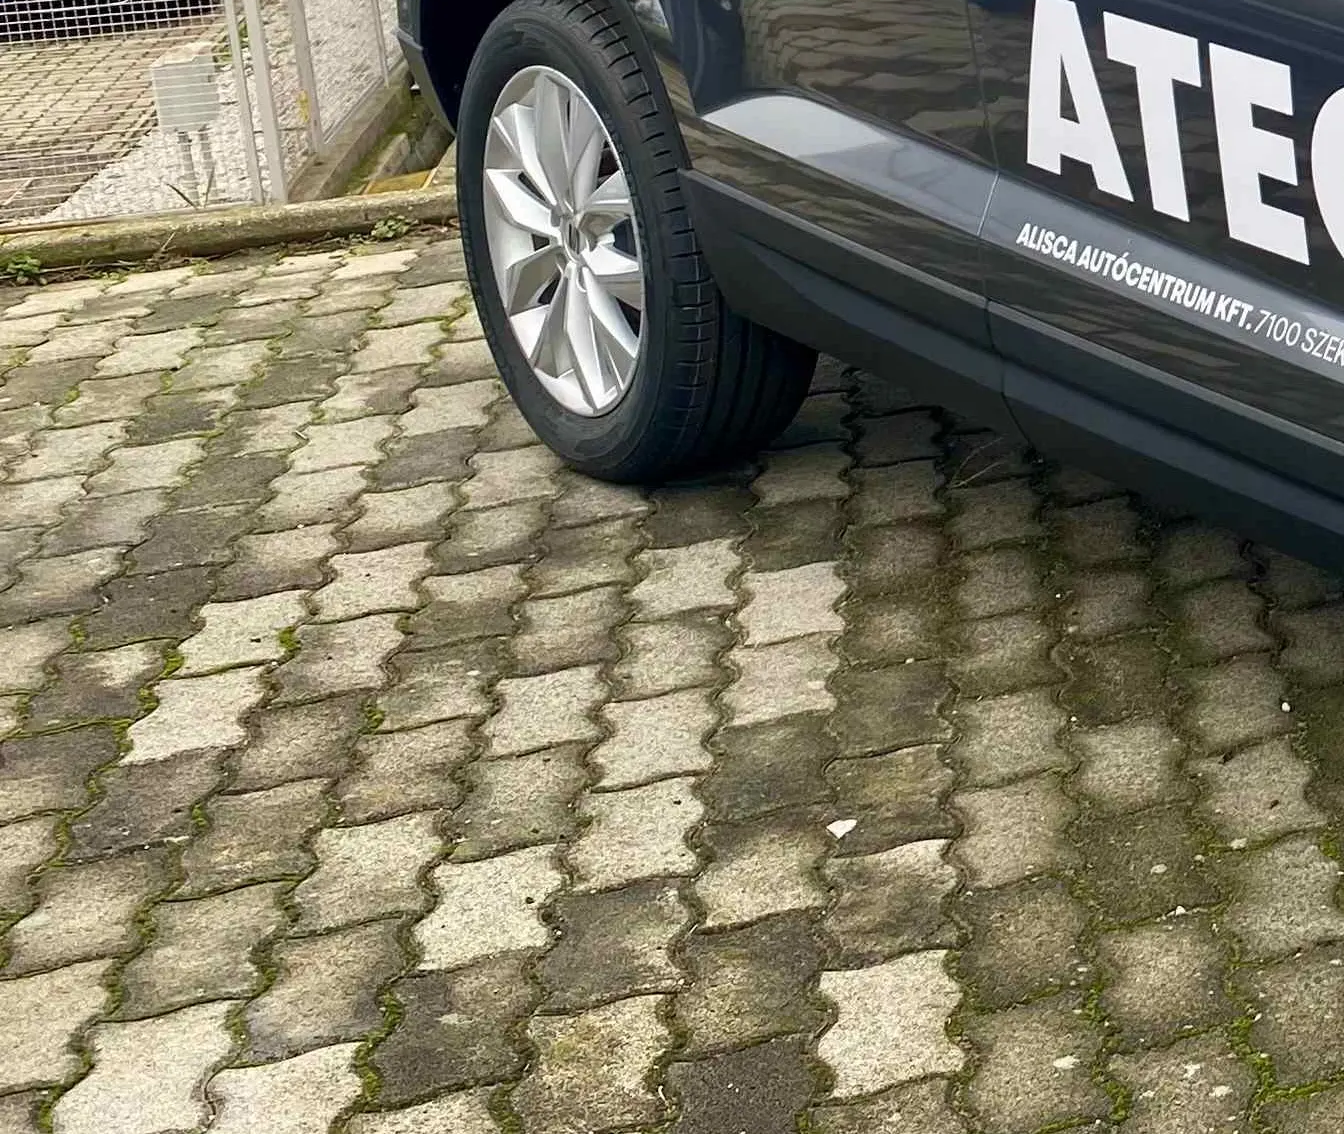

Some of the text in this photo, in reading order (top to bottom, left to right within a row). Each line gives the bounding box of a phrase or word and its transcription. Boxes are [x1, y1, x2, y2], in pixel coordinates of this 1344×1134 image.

[1015, 223, 1078, 267] ALISCA
[1078, 245, 1216, 317] AUTÓCENTRUM
[1213, 294, 1254, 331] KFT.
[1253, 309, 1302, 347] 7100
